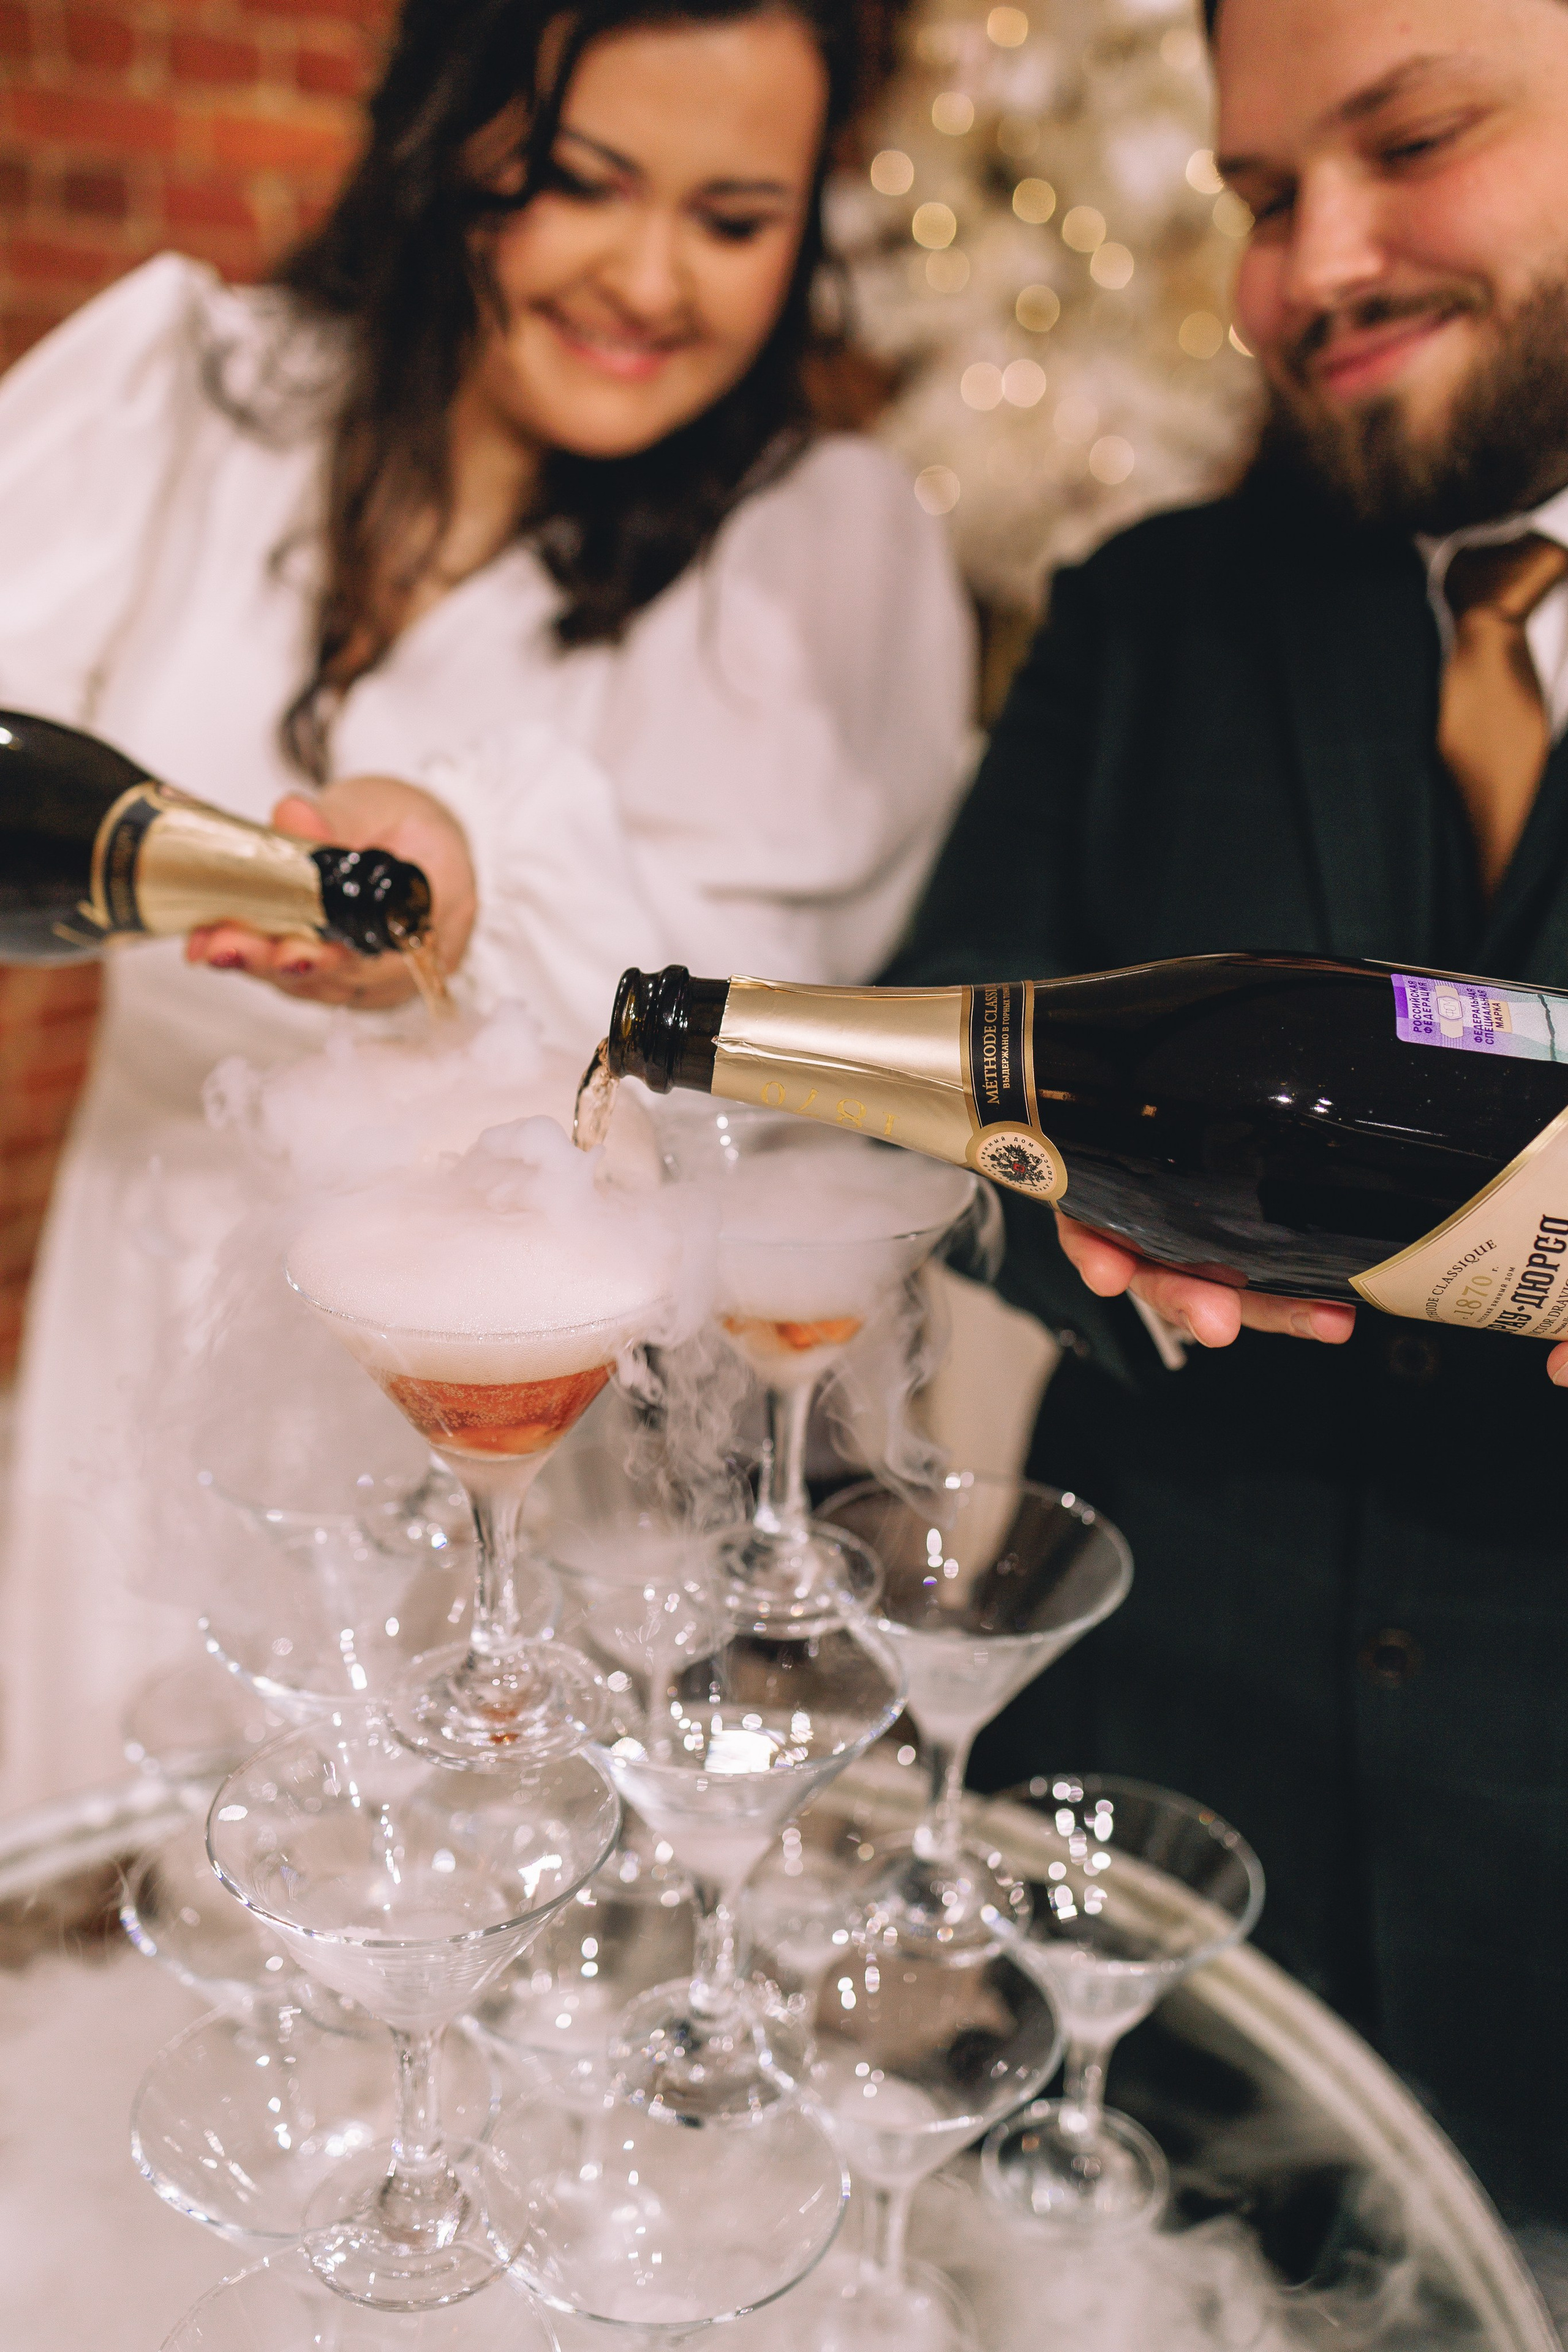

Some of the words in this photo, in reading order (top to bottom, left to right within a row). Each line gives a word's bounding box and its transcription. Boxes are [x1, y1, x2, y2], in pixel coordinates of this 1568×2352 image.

[984, 984, 998, 1023] CLASSI
[1408, 981, 1422, 1033] РОССИЙСКАЯ
[1418, 982, 1433, 1033] ФЕДЕРАЦИЯ
[1466, 988, 1483, 1042] ФЕДЕРАЛЬНАЯ
[1477, 990, 1494, 1044] СПЕЦИАЛЬНАЯ
[1492, 1003, 1504, 1028] МАРКА
[982, 1025, 1000, 1104] MÉTHODE
[1001, 1033, 1010, 1088] ВЫДЕРЖАНО
[1014, 1137, 1034, 1148] ДОМ
[1432, 1240, 1497, 1295] CLASSIQUE
[1491, 1284, 1507, 1306] ВИННЫЙ
[1505, 1267, 1515, 1281] ДОМ
[1453, 1276, 1493, 1316] 1870
